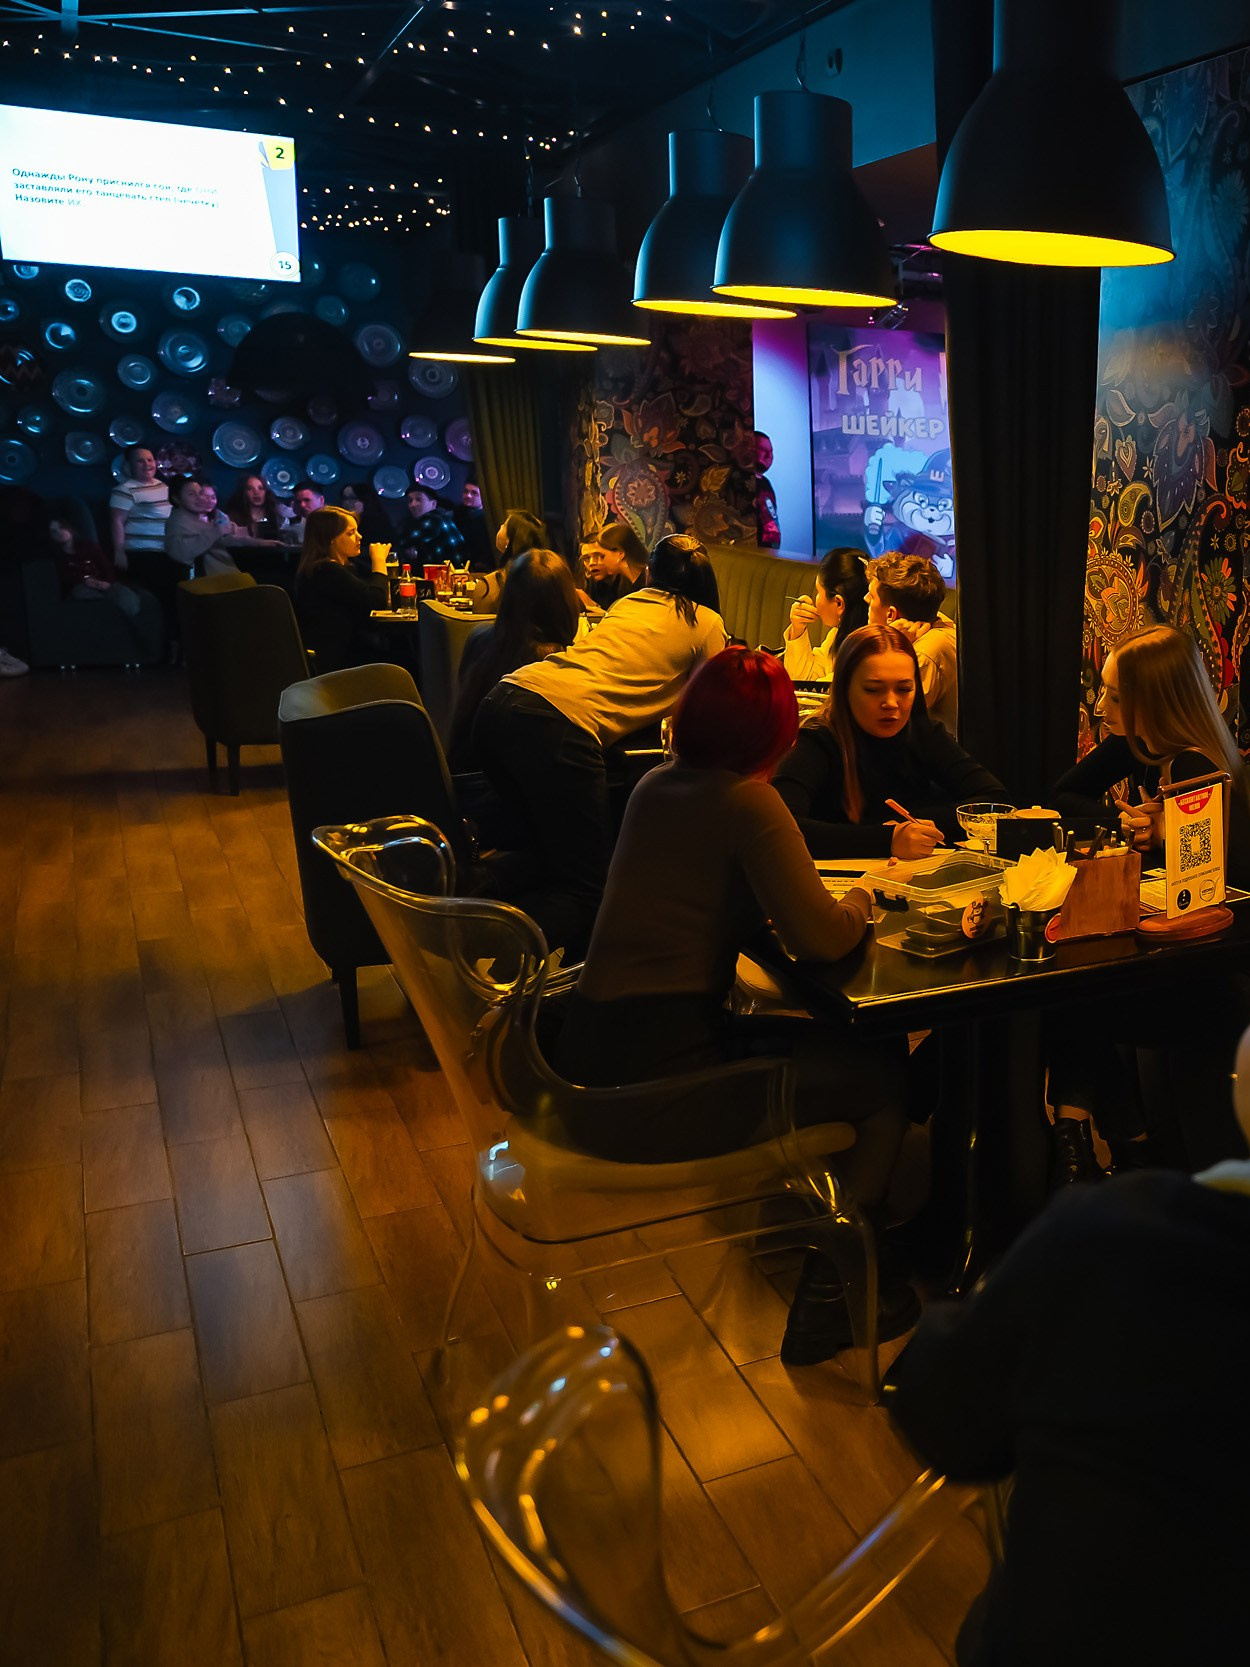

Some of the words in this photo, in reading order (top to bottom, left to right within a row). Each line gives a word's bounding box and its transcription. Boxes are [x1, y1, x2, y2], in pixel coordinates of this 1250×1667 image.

[275, 147, 285, 159] 2
[12, 168, 66, 182] Однажды
[13, 181, 73, 194] заставляли
[76, 188, 93, 197] его
[95, 190, 147, 201] танцевать
[149, 195, 171, 204] степ
[15, 193, 65, 205] Назовите
[278, 260, 292, 271] 15
[830, 344, 922, 395] Гарри
[842, 411, 944, 439] ШЕЙКЕР
